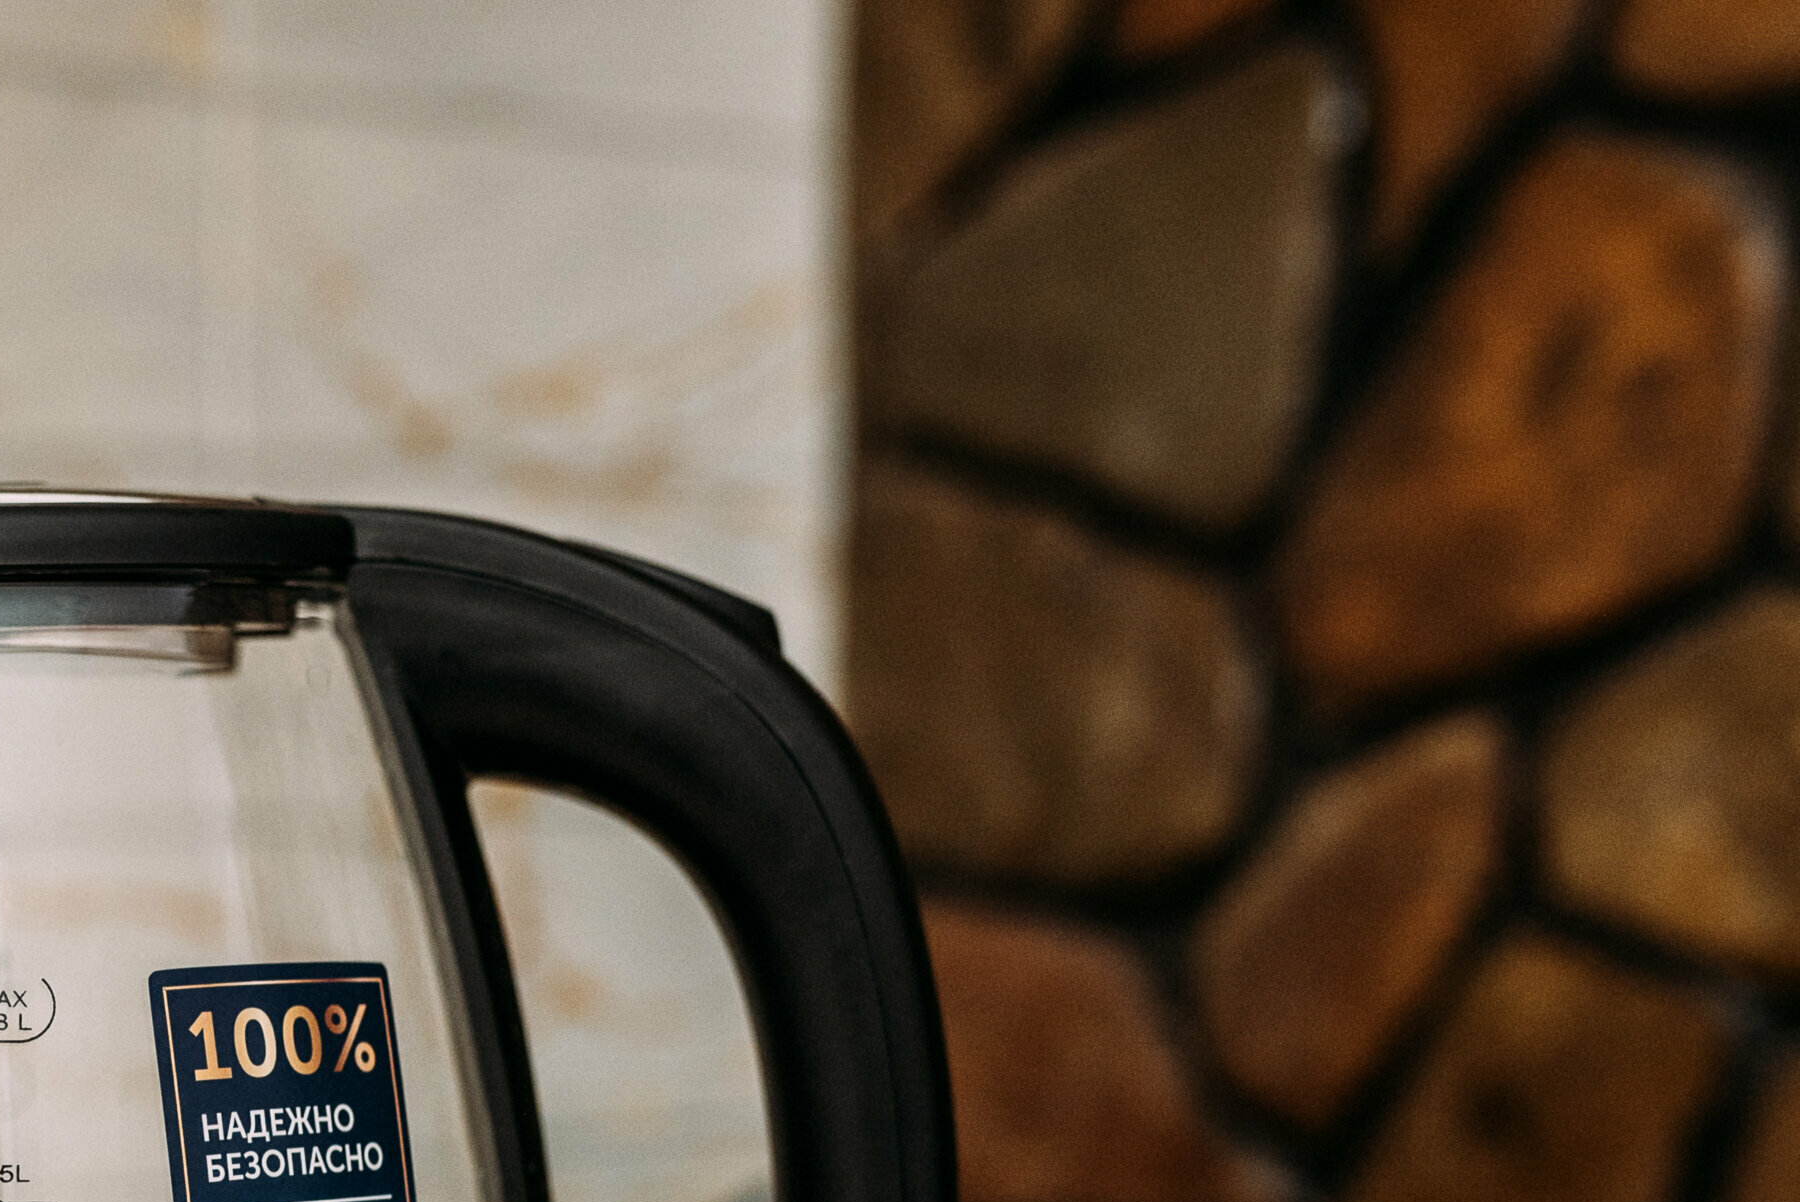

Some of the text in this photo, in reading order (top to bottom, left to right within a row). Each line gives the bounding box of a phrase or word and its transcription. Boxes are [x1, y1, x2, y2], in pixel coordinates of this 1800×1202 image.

[18, 1013, 32, 1031] L
[188, 1003, 376, 1081] 100%
[201, 1103, 355, 1143] НАДЕЖНО
[206, 1142, 384, 1183] БЕЗОПАСНО
